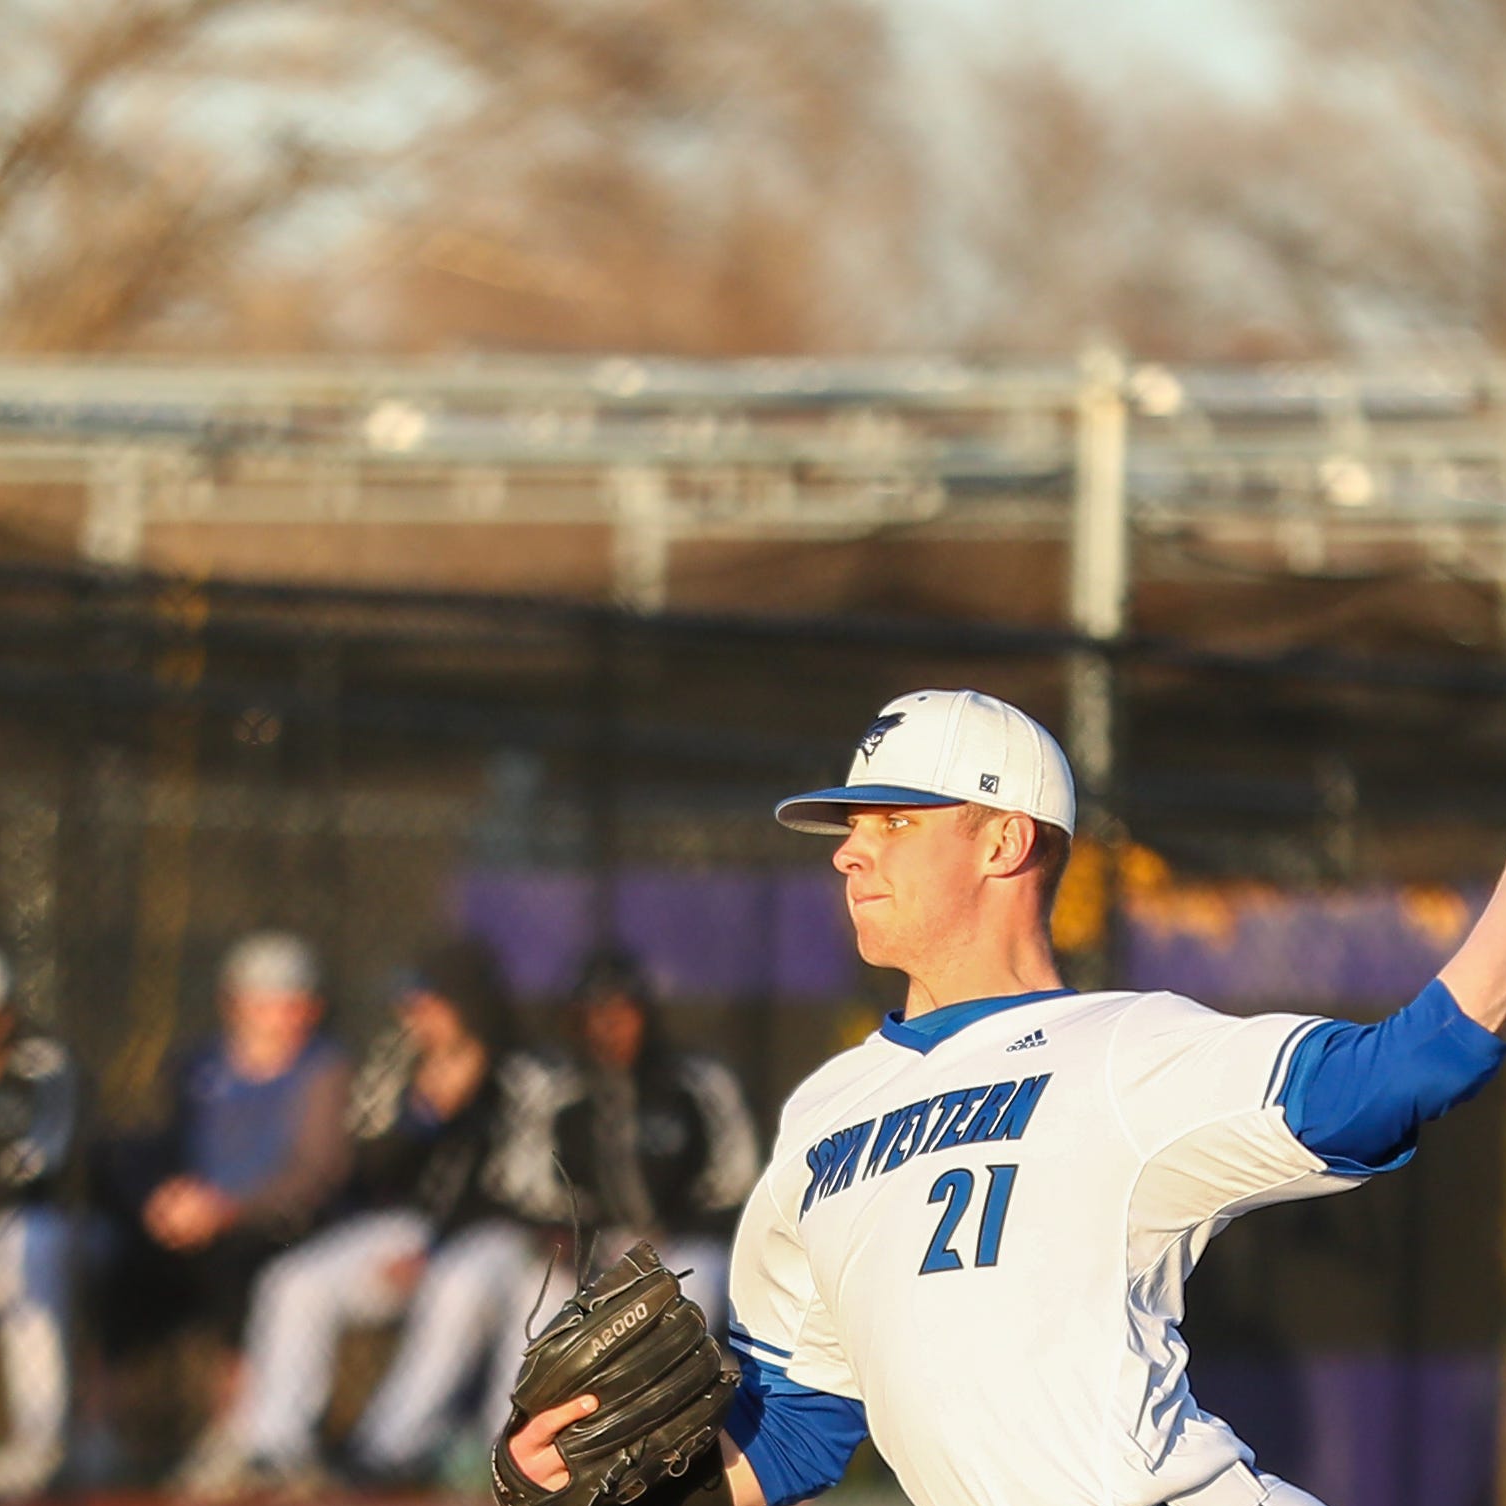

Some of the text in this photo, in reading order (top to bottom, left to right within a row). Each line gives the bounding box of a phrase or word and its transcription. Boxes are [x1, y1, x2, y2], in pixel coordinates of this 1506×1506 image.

[861, 1072, 1054, 1181] WESTERN
[918, 1163, 1019, 1276] 21
[591, 1302, 648, 1357] A2000
